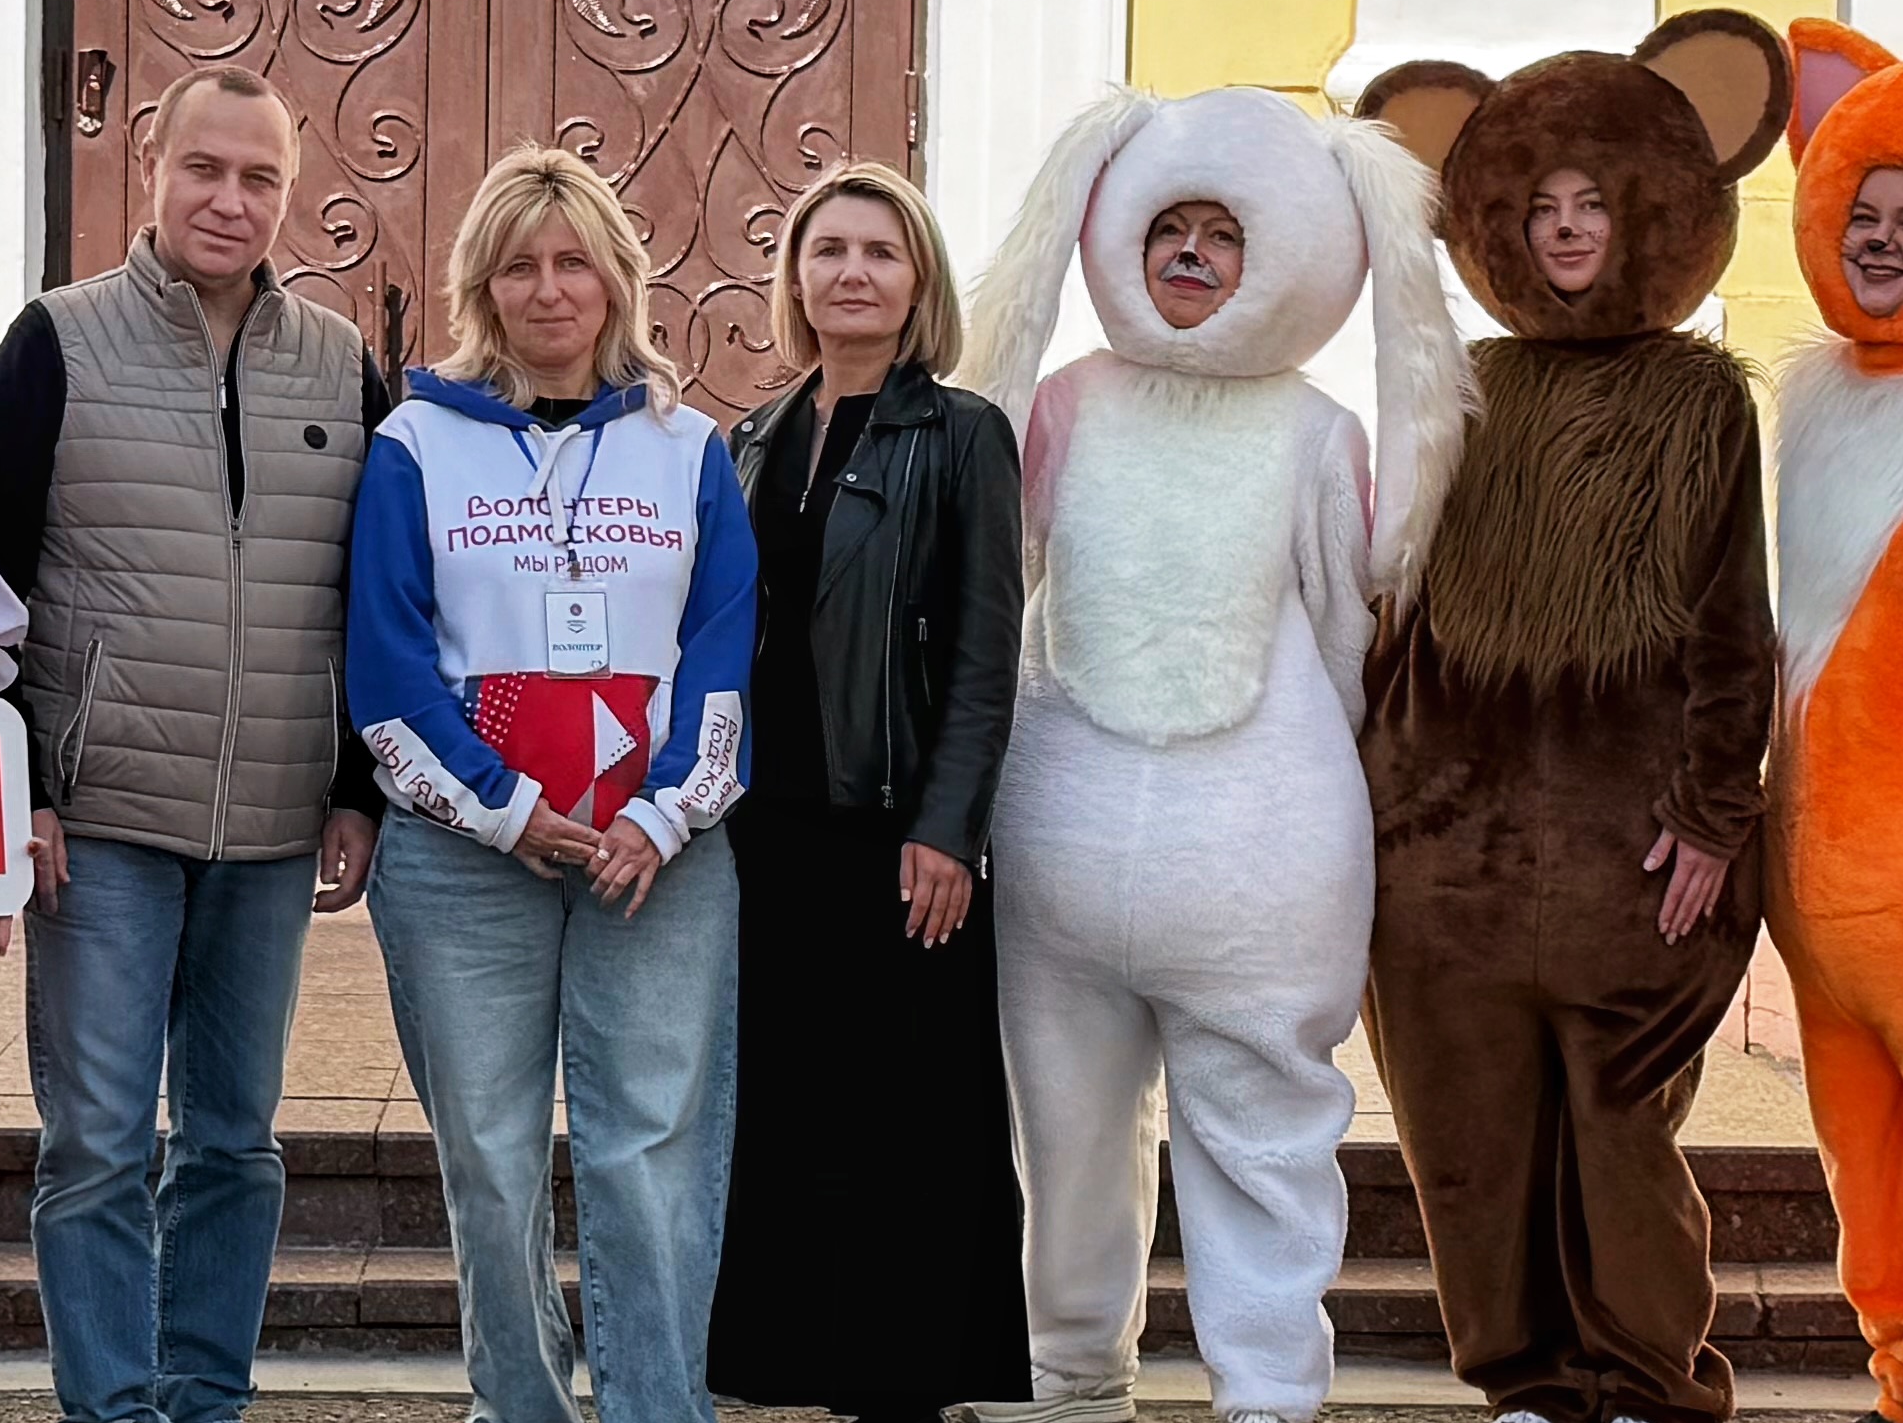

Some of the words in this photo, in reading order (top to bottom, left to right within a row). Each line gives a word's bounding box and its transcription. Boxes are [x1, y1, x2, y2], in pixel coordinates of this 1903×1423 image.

[513, 554, 549, 573] МЫ
[554, 554, 629, 574] РДОМ
[370, 723, 414, 777] МЫ
